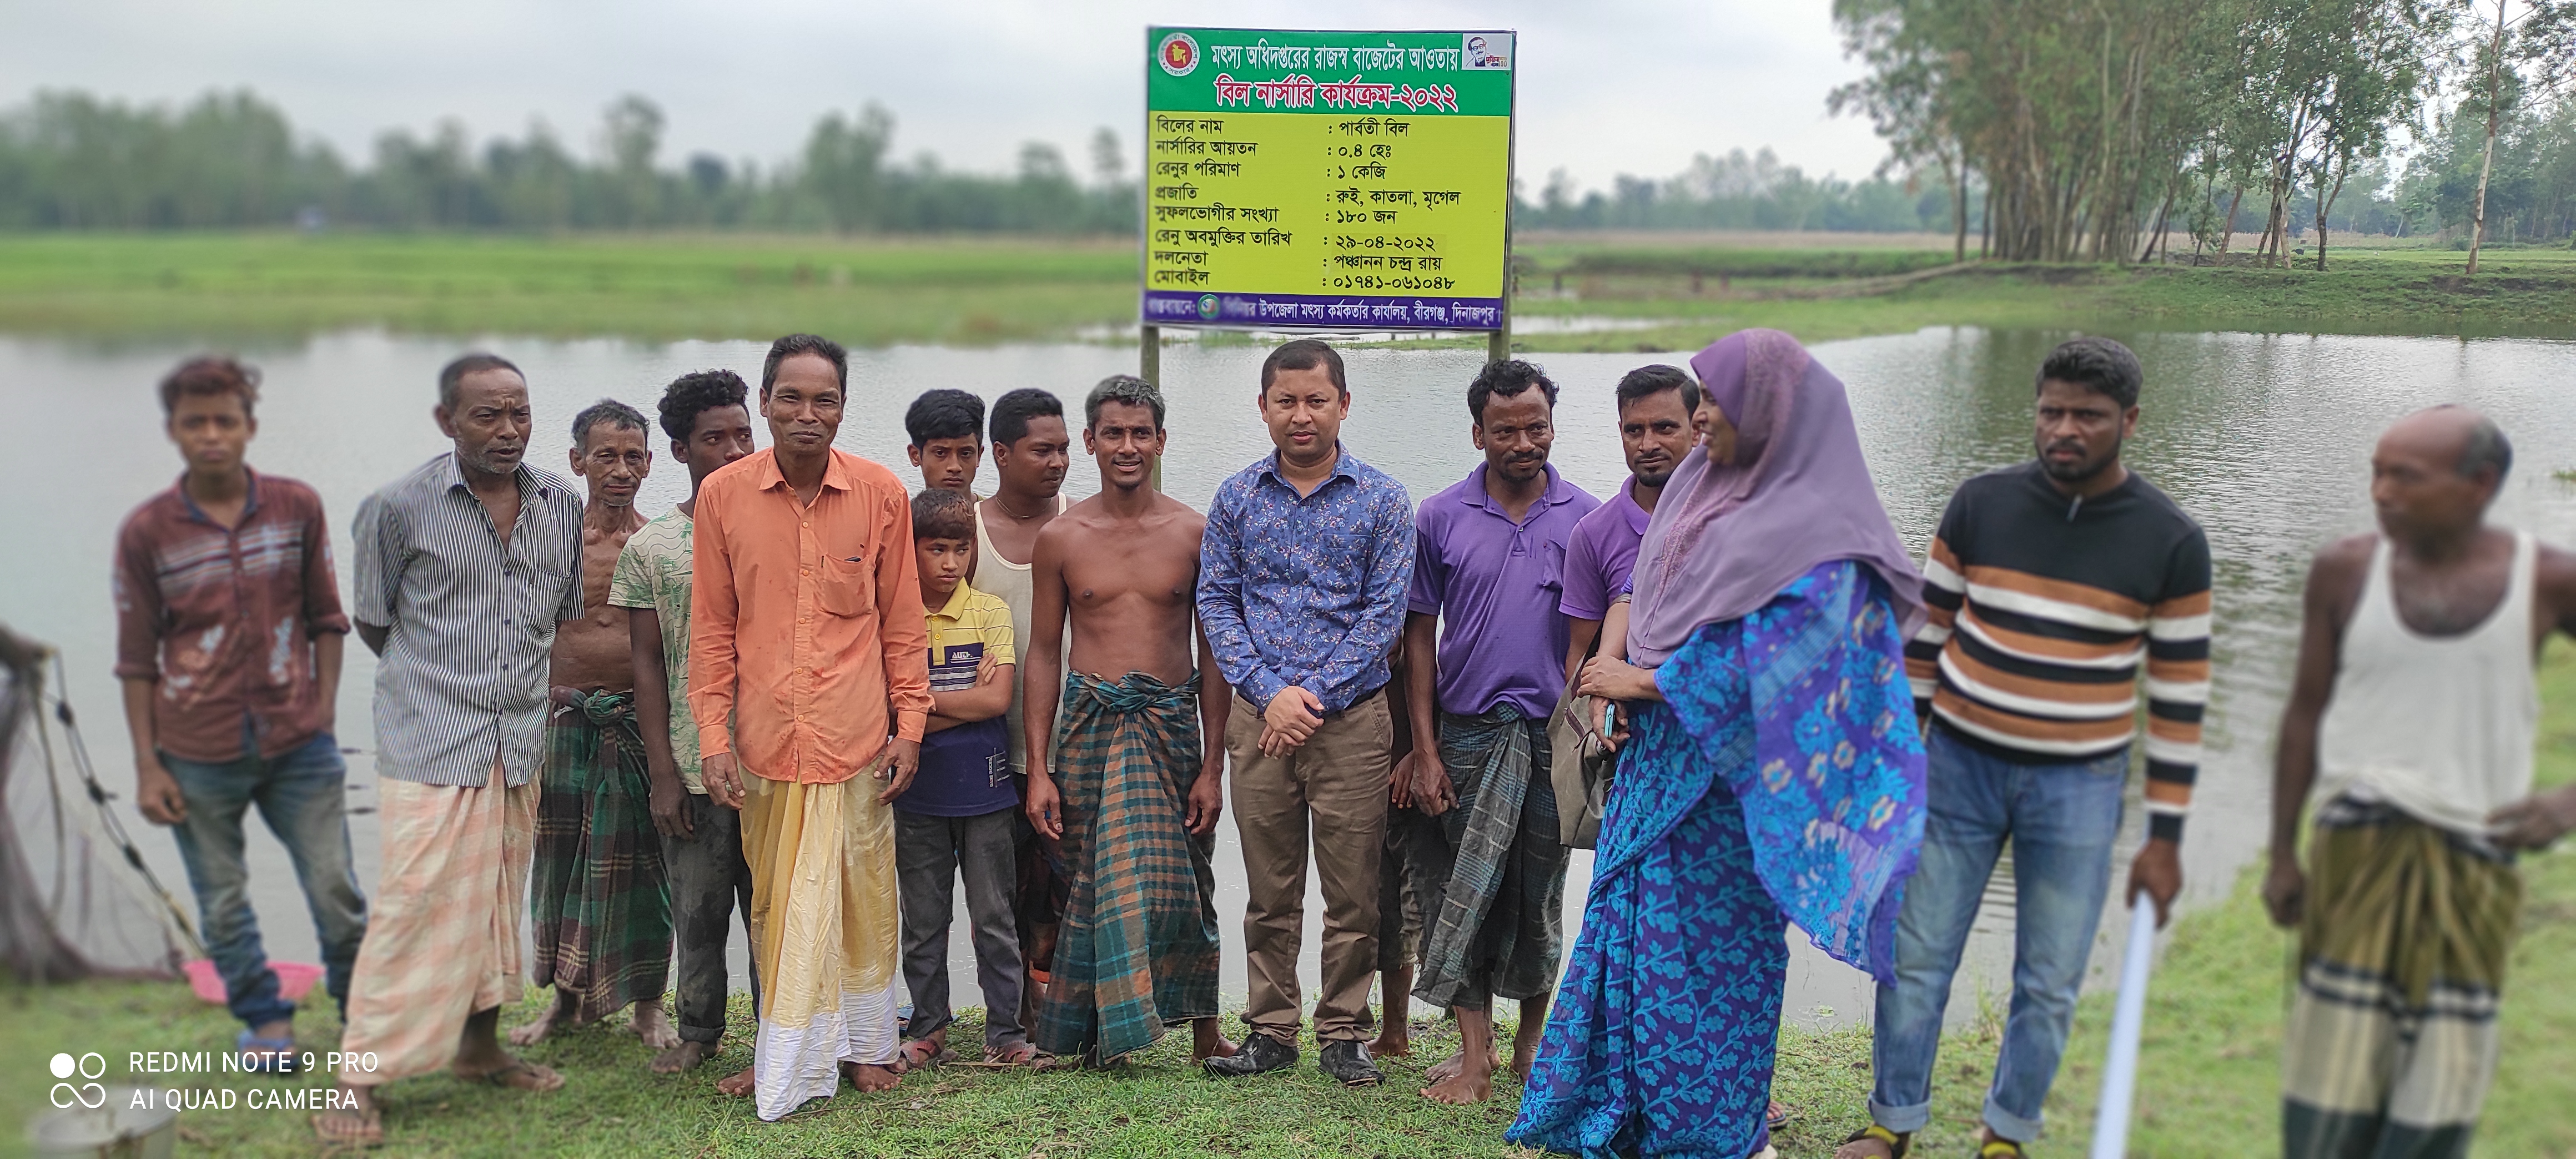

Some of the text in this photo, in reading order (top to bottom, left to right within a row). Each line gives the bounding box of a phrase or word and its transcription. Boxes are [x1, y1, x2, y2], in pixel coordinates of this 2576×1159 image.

[1210, 46, 1243, 69] মৎস্য
[1245, 38, 1311, 70] অধিদপ্তরের
[1314, 44, 1350, 71] রাজস্ব
[1352, 39, 1406, 71] বাজেটের
[1408, 45, 1460, 72] আওতায়
[1213, 73, 1458, 113] বিল নার্সারি কার্যক্রম-২০২২
[1156, 114, 1196, 134] বিলের
[1199, 118, 1224, 134] নাম
[1339, 117, 1381, 137] পার্বতী
[1383, 118, 1411, 137] বিল
[1155, 136, 1206, 155] নার্সারির
[1209, 140, 1259, 157] আয়তন
[1338, 144, 1362, 157] ০.৪
[1156, 162, 1190, 179] রেনুর
[1194, 158, 1241, 177] পরিমাণ
[1337, 165, 1345, 179] ১
[1352, 160, 1388, 180] কেজি
[1155, 182, 1199, 200] প্রজাতি
[1335, 185, 1364, 207] রুই,
[1368, 189, 1417, 208] কাতলা,
[1422, 189, 1462, 211] মৃগেল
[1155, 202, 1236, 223] সুফলভোগীর
[1239, 206, 1280, 223] সংখ্যা
[1337, 209, 1367, 224] ১৮০
[1371, 210, 1398, 225] জন
[1155, 229, 1181, 246] রেনু
[1184, 226, 1246, 248] অবমুক্তির
[1249, 227, 1293, 247] তারিখ
[1335, 235, 1436, 253] ২৯-০৪-২০২২
[1154, 250, 1209, 266] দলনেতা
[1334, 254, 1385, 270] পঞ্চানন
[1387, 256, 1414, 273] চন্দ্র
[1417, 255, 1443, 271] রায়
[1154, 266, 1211, 286] মোবাইল
[1334, 275, 1456, 290] ০১৭৪১-০৬১০৪৮
[1259, 298, 1299, 319] উপজেলা
[1301, 304, 1325, 319] মৎস্য
[1327, 299, 1370, 321] কর্মকর্তার
[1371, 299, 1410, 324] কার্যালয়,
[1413, 300, 1448, 325] বীরগঞ্জ,
[1452, 301, 1495, 326] দিনাজপুর
